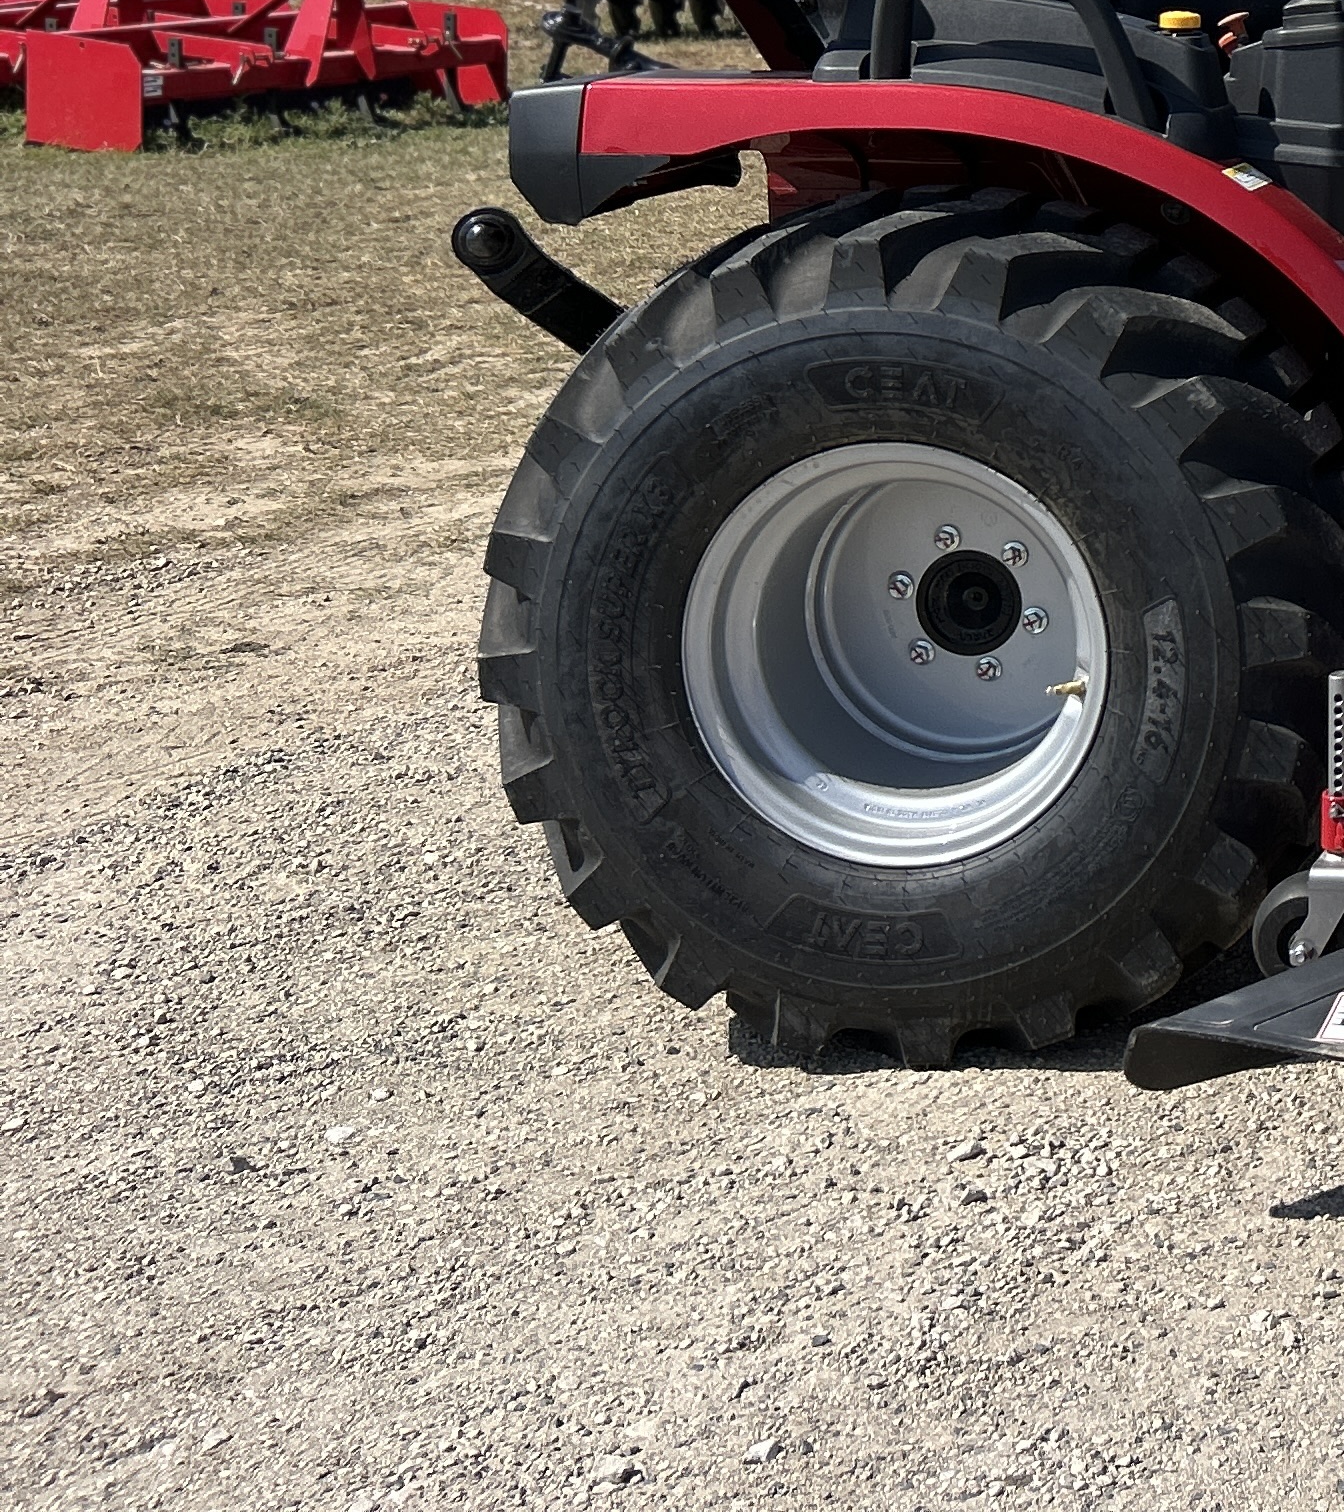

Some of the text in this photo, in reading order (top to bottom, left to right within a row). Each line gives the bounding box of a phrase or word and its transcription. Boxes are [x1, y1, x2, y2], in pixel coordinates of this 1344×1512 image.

[843, 365, 967, 409] CEAT
[1142, 629, 1180, 753] 12.4-16
[802, 910, 925, 955] CEAT
